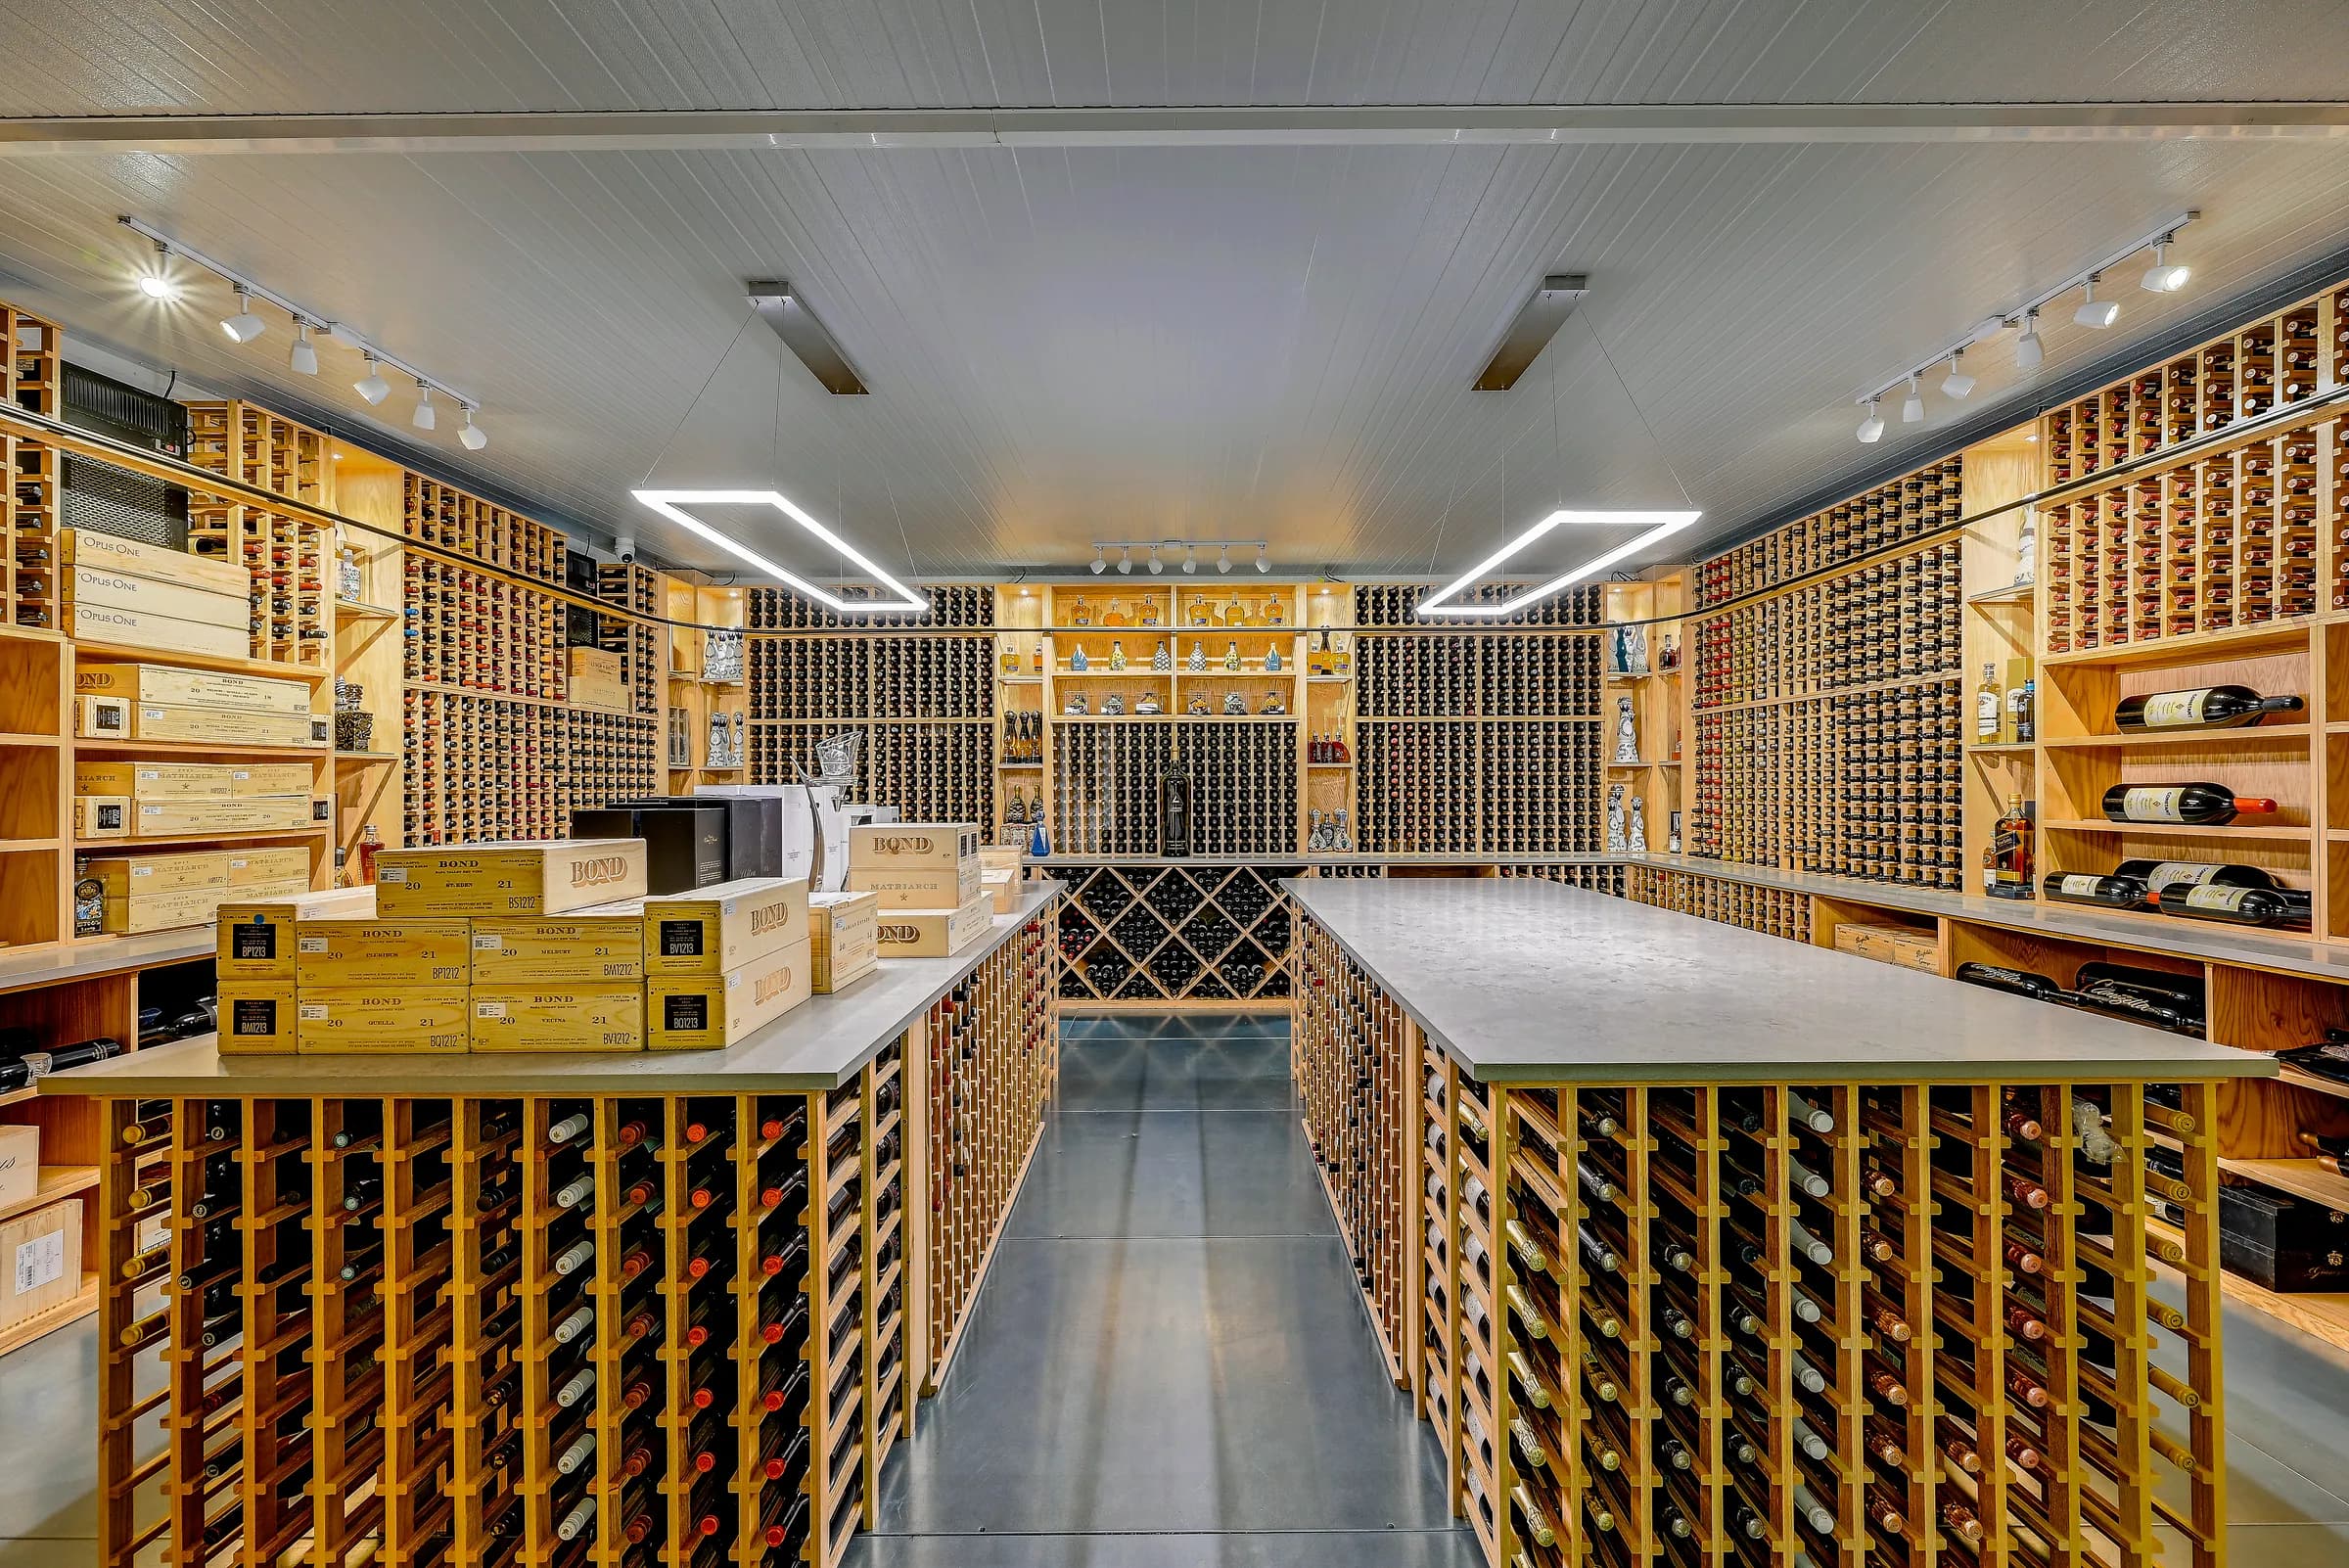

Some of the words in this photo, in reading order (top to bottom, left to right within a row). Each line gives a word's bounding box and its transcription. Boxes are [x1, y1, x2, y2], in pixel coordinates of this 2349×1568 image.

[75, 672, 115, 689] OND
[872, 837, 935, 855] BOND
[154, 863, 209, 873] MATRIARCH
[570, 856, 628, 888] BOND
[404, 882, 421, 891] 20
[497, 880, 514, 889] 21
[508, 896, 535, 909] BS1212
[750, 901, 789, 937] BOND
[878, 925, 921, 944] OND
[242, 946, 266, 957] BP1213
[421, 950, 437, 959] 21
[669, 943, 694, 954] BV1213
[327, 951, 343, 960] 20
[433, 967, 460, 980] BP1212
[603, 963, 633, 976] BM1212
[754, 965, 792, 1006] BOND
[241, 1022, 267, 1034] BM1213
[673, 1017, 699, 1029] BQ1213
[430, 1035, 458, 1047] BQ1212
[603, 1033, 630, 1044] BV1212
